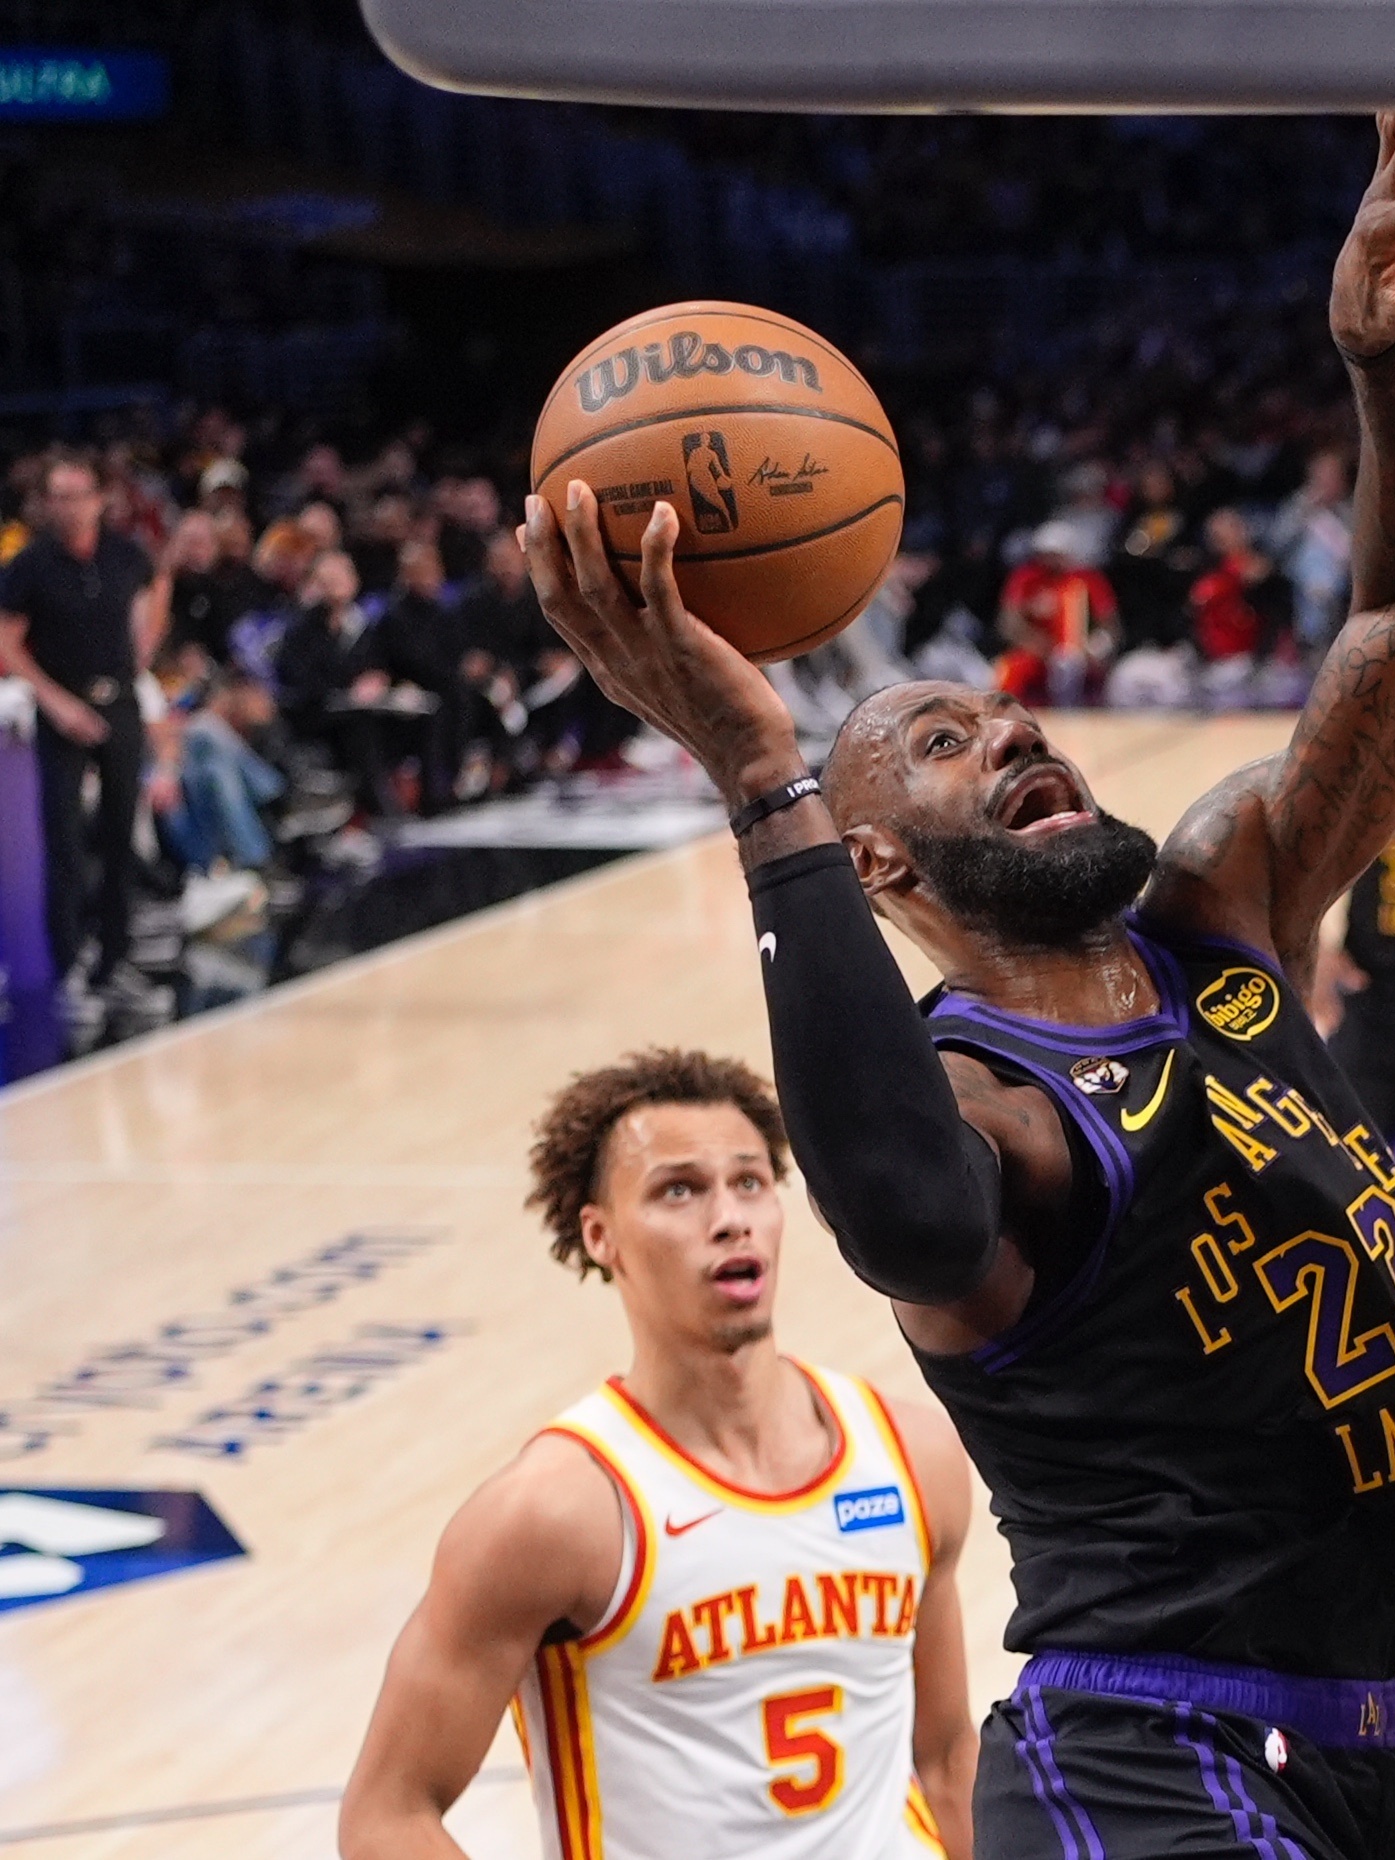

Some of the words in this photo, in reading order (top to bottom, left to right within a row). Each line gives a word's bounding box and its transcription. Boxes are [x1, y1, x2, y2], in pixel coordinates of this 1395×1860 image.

[574, 331, 823, 413] Wilson
[1203, 976, 1266, 1027] bibigo
[1174, 1182, 1256, 1355] LOS
[838, 1492, 899, 1527] paze
[651, 1570, 918, 1683] ATLANTA
[760, 1683, 846, 1818] 5
